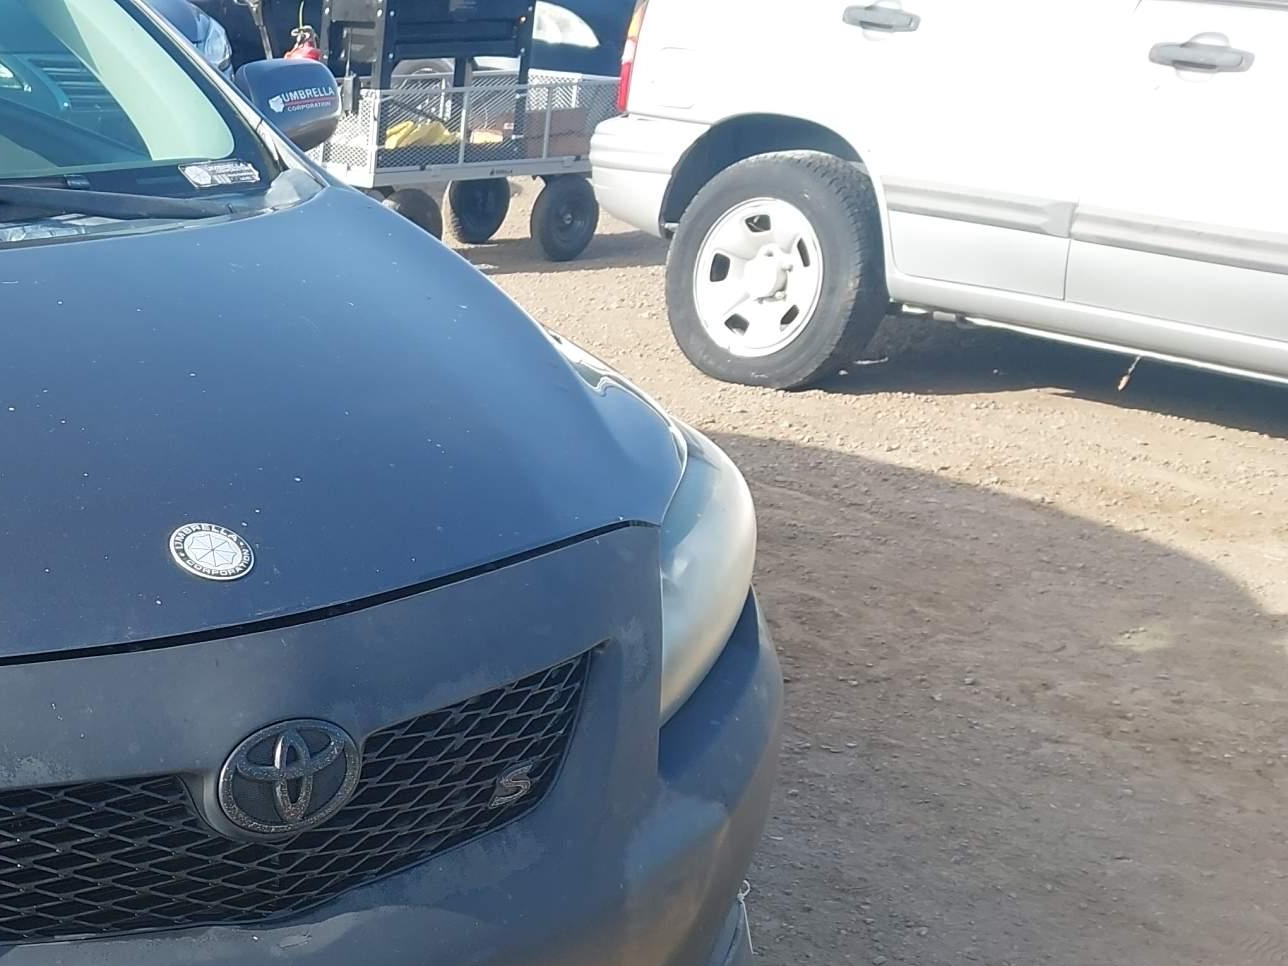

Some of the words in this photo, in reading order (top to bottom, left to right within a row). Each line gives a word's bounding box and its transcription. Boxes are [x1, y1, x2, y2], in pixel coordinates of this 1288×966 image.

[281, 86, 335, 102] UMBRELLA
[287, 101, 331, 112] CORPORATION
[174, 523, 238, 550] UMBRELLA
[186, 547, 251, 577] CORPORATION
